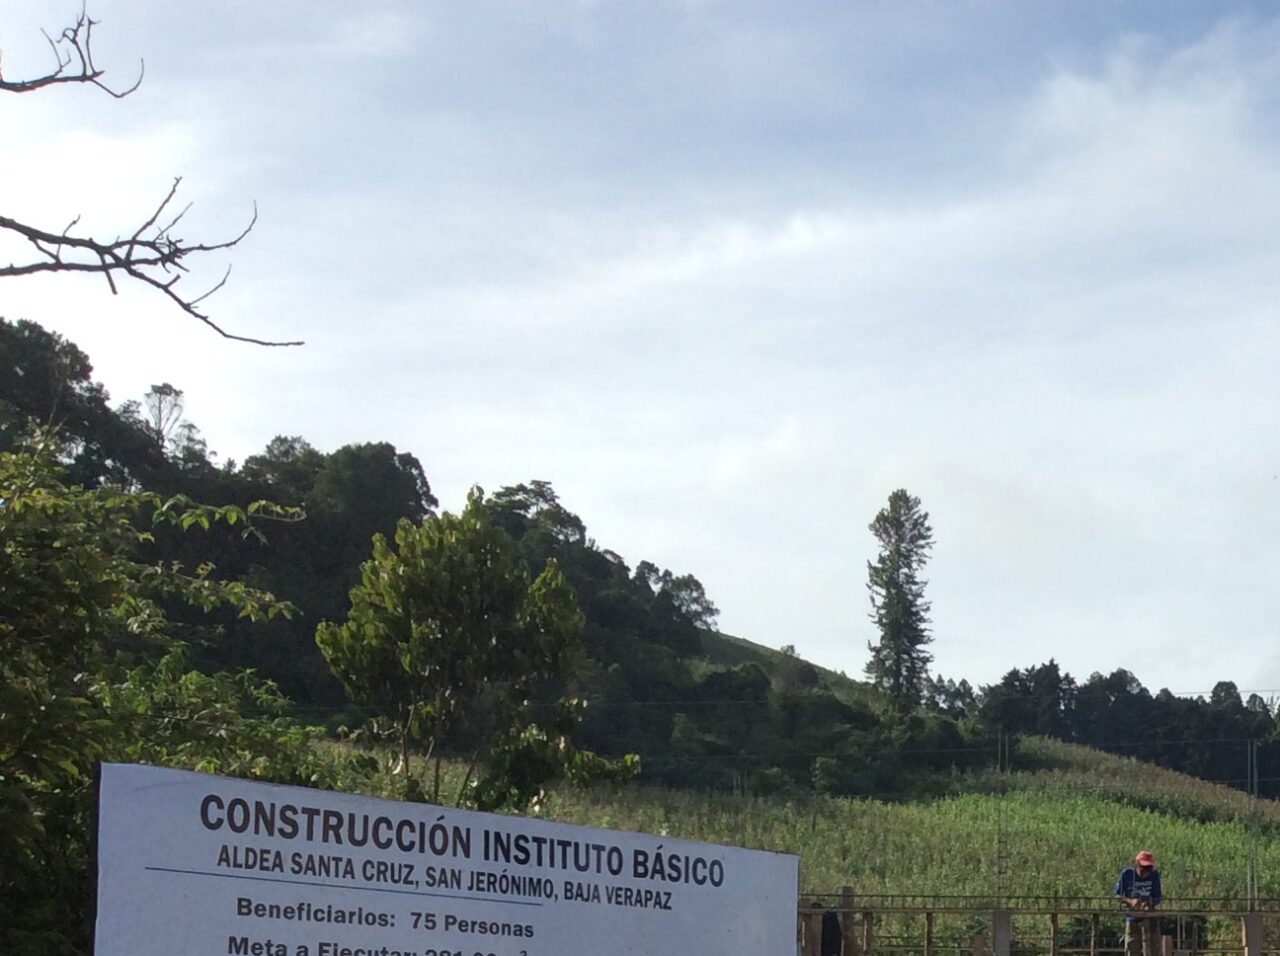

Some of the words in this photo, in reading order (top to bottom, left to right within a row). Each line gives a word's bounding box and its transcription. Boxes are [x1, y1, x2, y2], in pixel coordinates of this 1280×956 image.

[200, 794, 471, 858] CONSTRUCCIÓN
[483, 829, 623, 876] INSTITUTO
[633, 844, 725, 887] BÁSICO
[217, 845, 284, 873] ALDEA
[290, 851, 355, 879] SANTA
[362, 859, 419, 889] CRUZ,
[425, 866, 461, 891] SAN
[467, 868, 558, 903] JERÓNIMO,
[563, 881, 601, 904] BAJA
[606, 885, 672, 910] VERAPAZ
[237, 897, 396, 928] Beneficiarios:
[410, 912, 436, 930] 75
[444, 914, 534, 938] Personas
